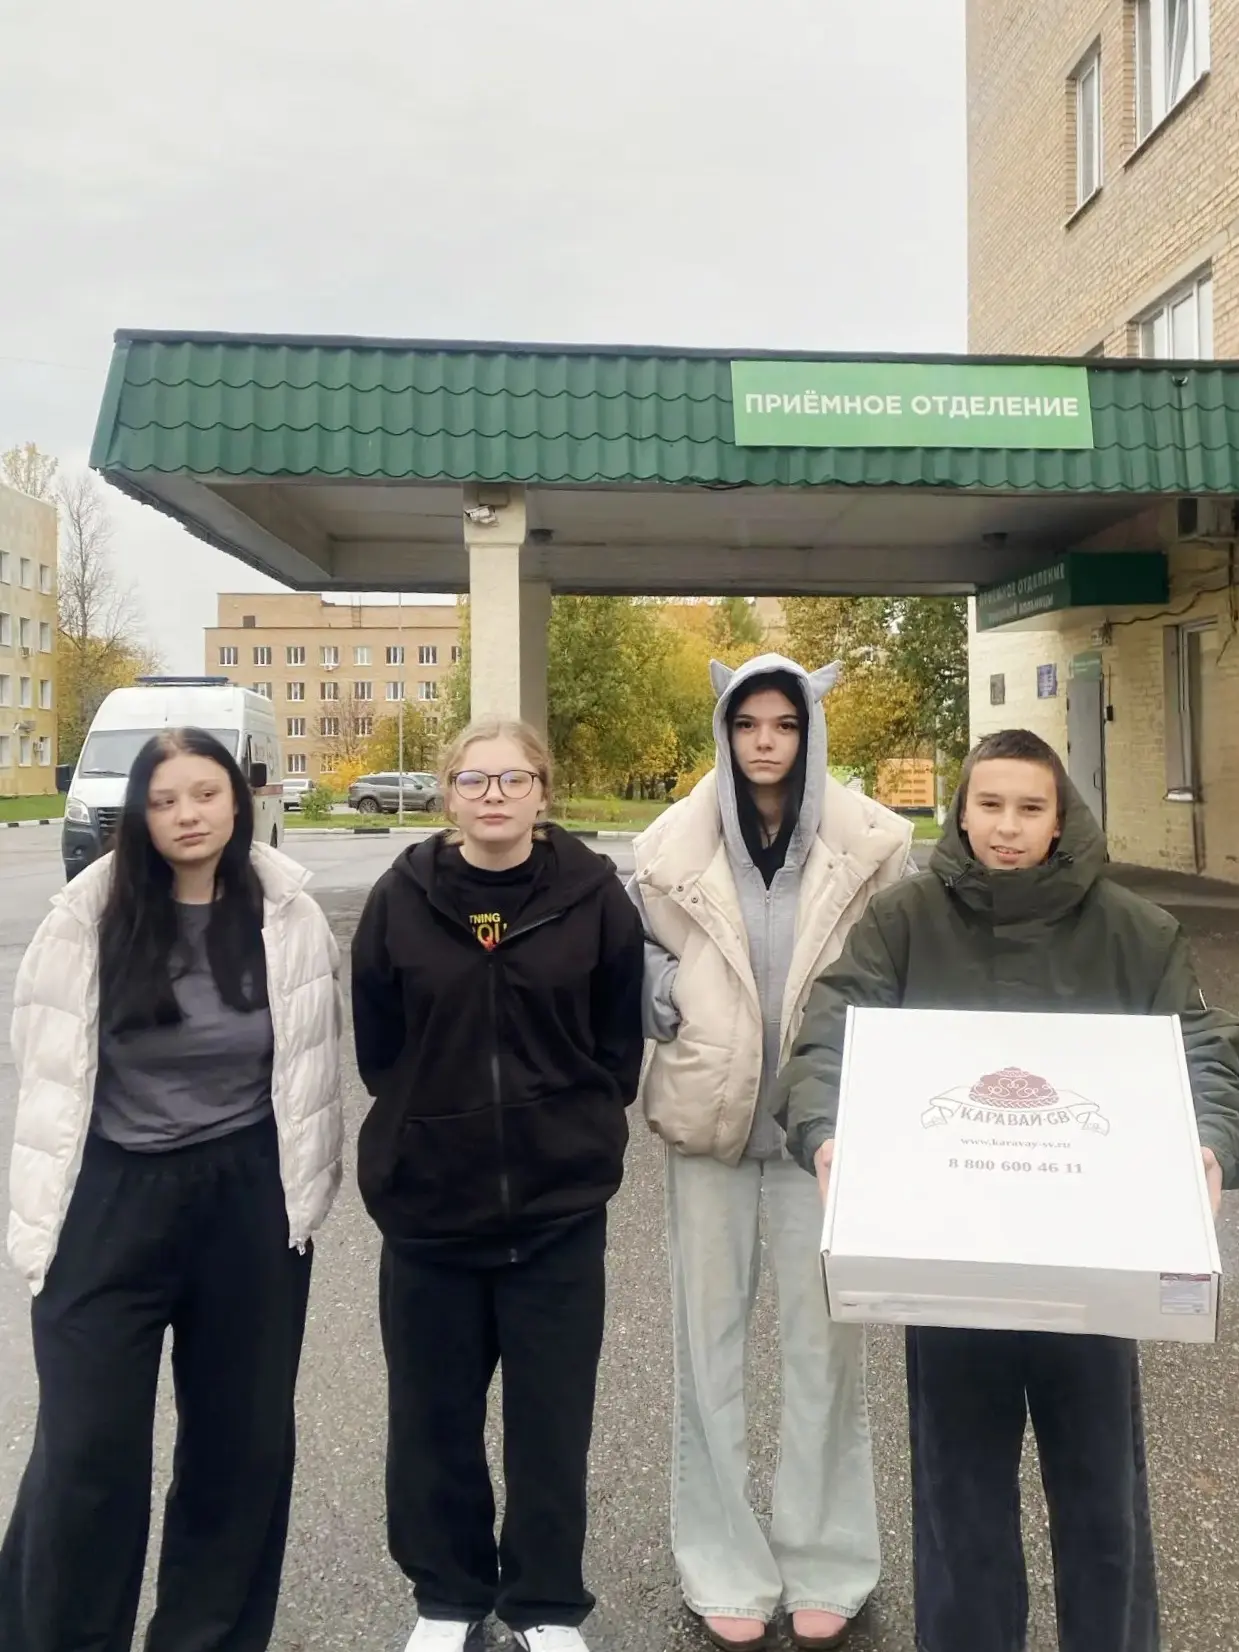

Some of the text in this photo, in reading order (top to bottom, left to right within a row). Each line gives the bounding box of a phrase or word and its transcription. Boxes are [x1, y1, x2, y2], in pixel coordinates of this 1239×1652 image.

[745, 390, 1080, 419] ПРИЁМНОЕ ОТДЕЛЕНИЕ
[960, 1138, 1071, 1150] www.karavay-sv.ru
[948, 1158, 1082, 1174] 8 800 600 46 11
